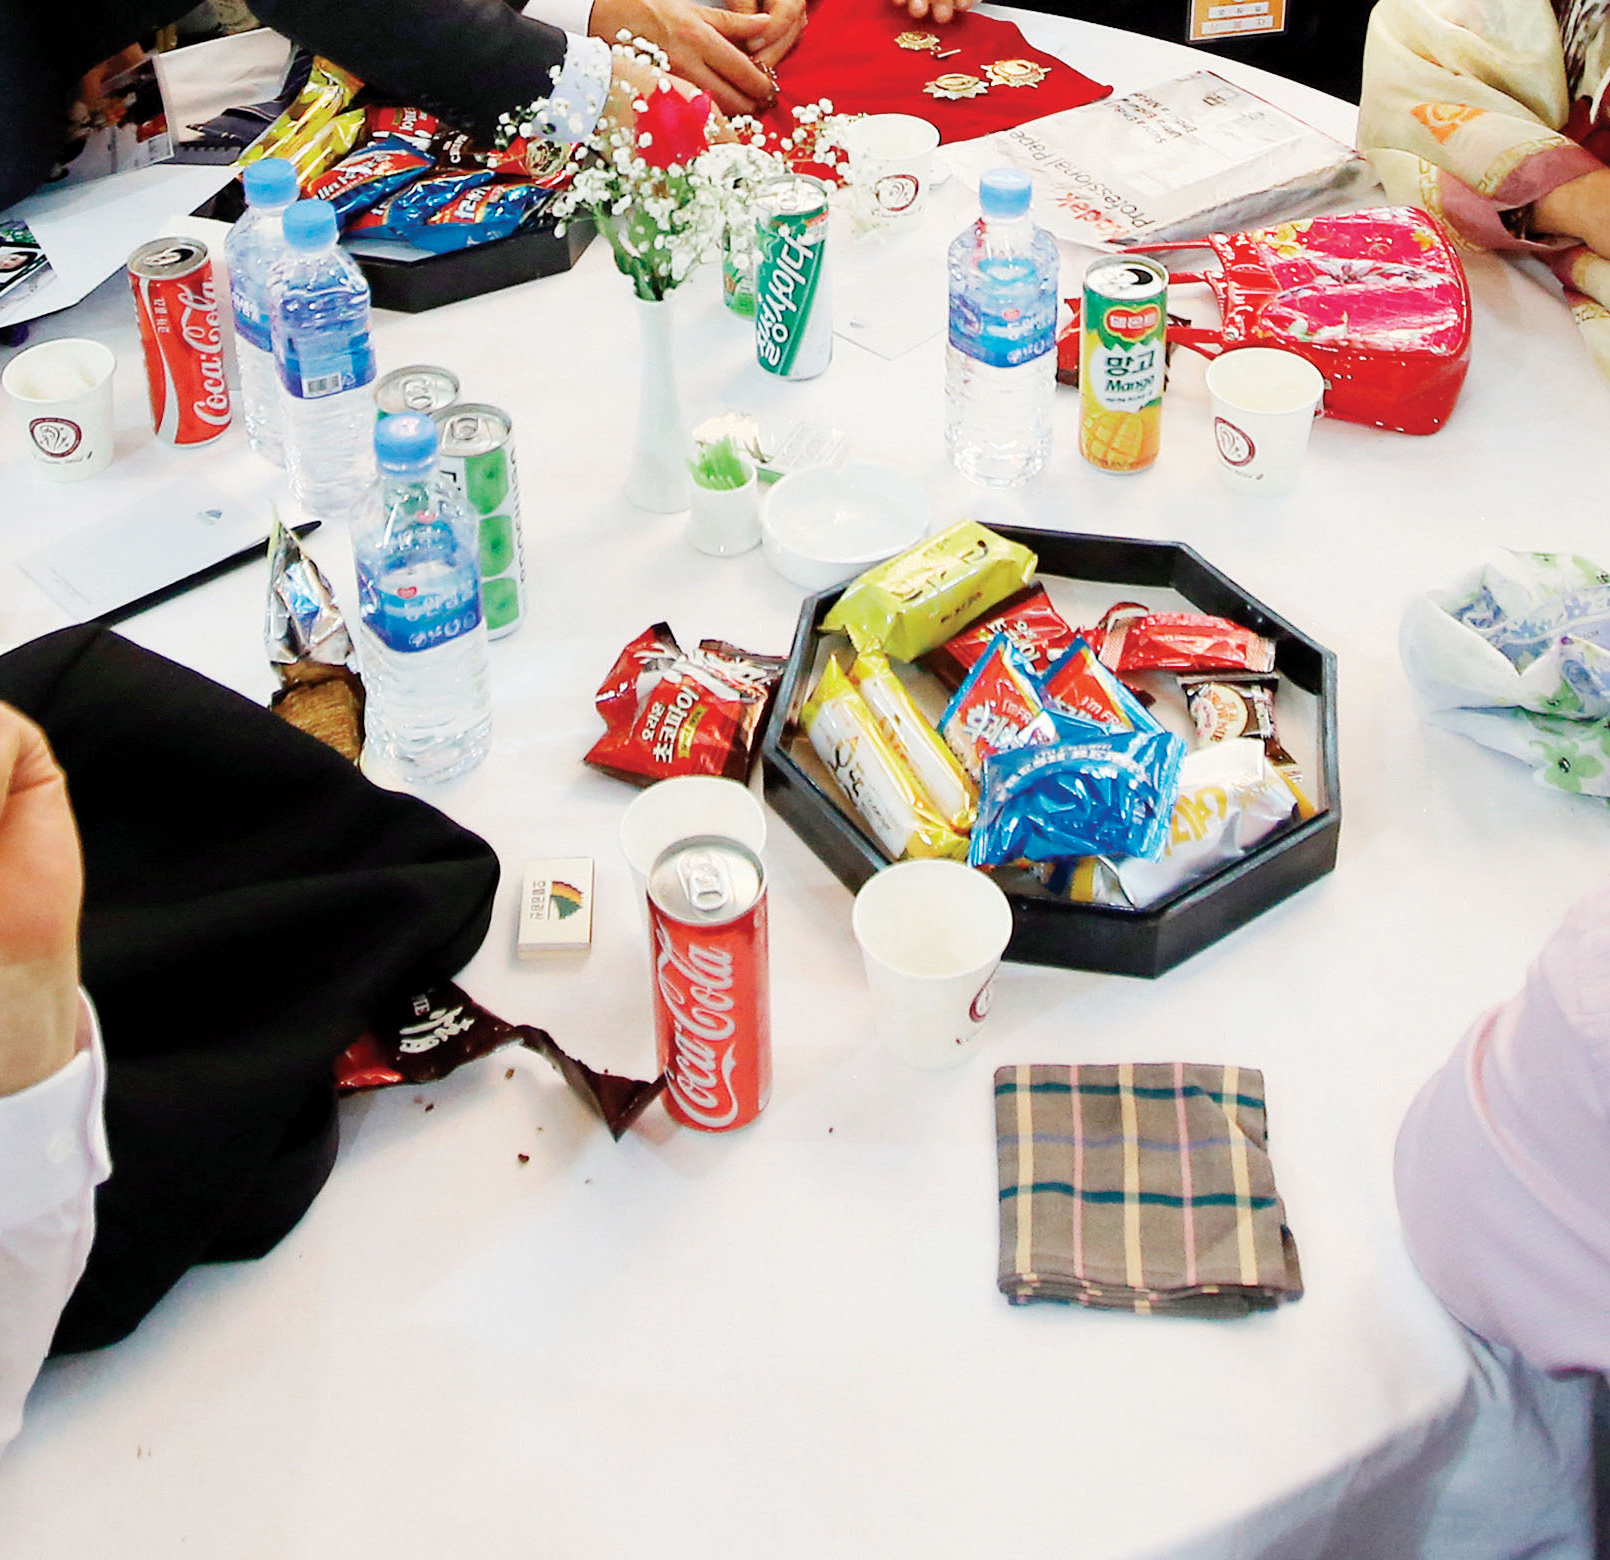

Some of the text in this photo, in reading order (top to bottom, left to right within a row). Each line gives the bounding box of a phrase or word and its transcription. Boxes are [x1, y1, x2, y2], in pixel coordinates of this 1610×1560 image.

[1010, 130, 1155, 228] Professional Pape
[757, 228, 814, 367] 칠성사이다
[1105, 374, 1156, 393] Mango
[1106, 348, 1156, 378] 망고
[641, 701, 666, 742] 오리온
[653, 685, 700, 764] 초코파이
[656, 917, 739, 1128] Coca-Cola
